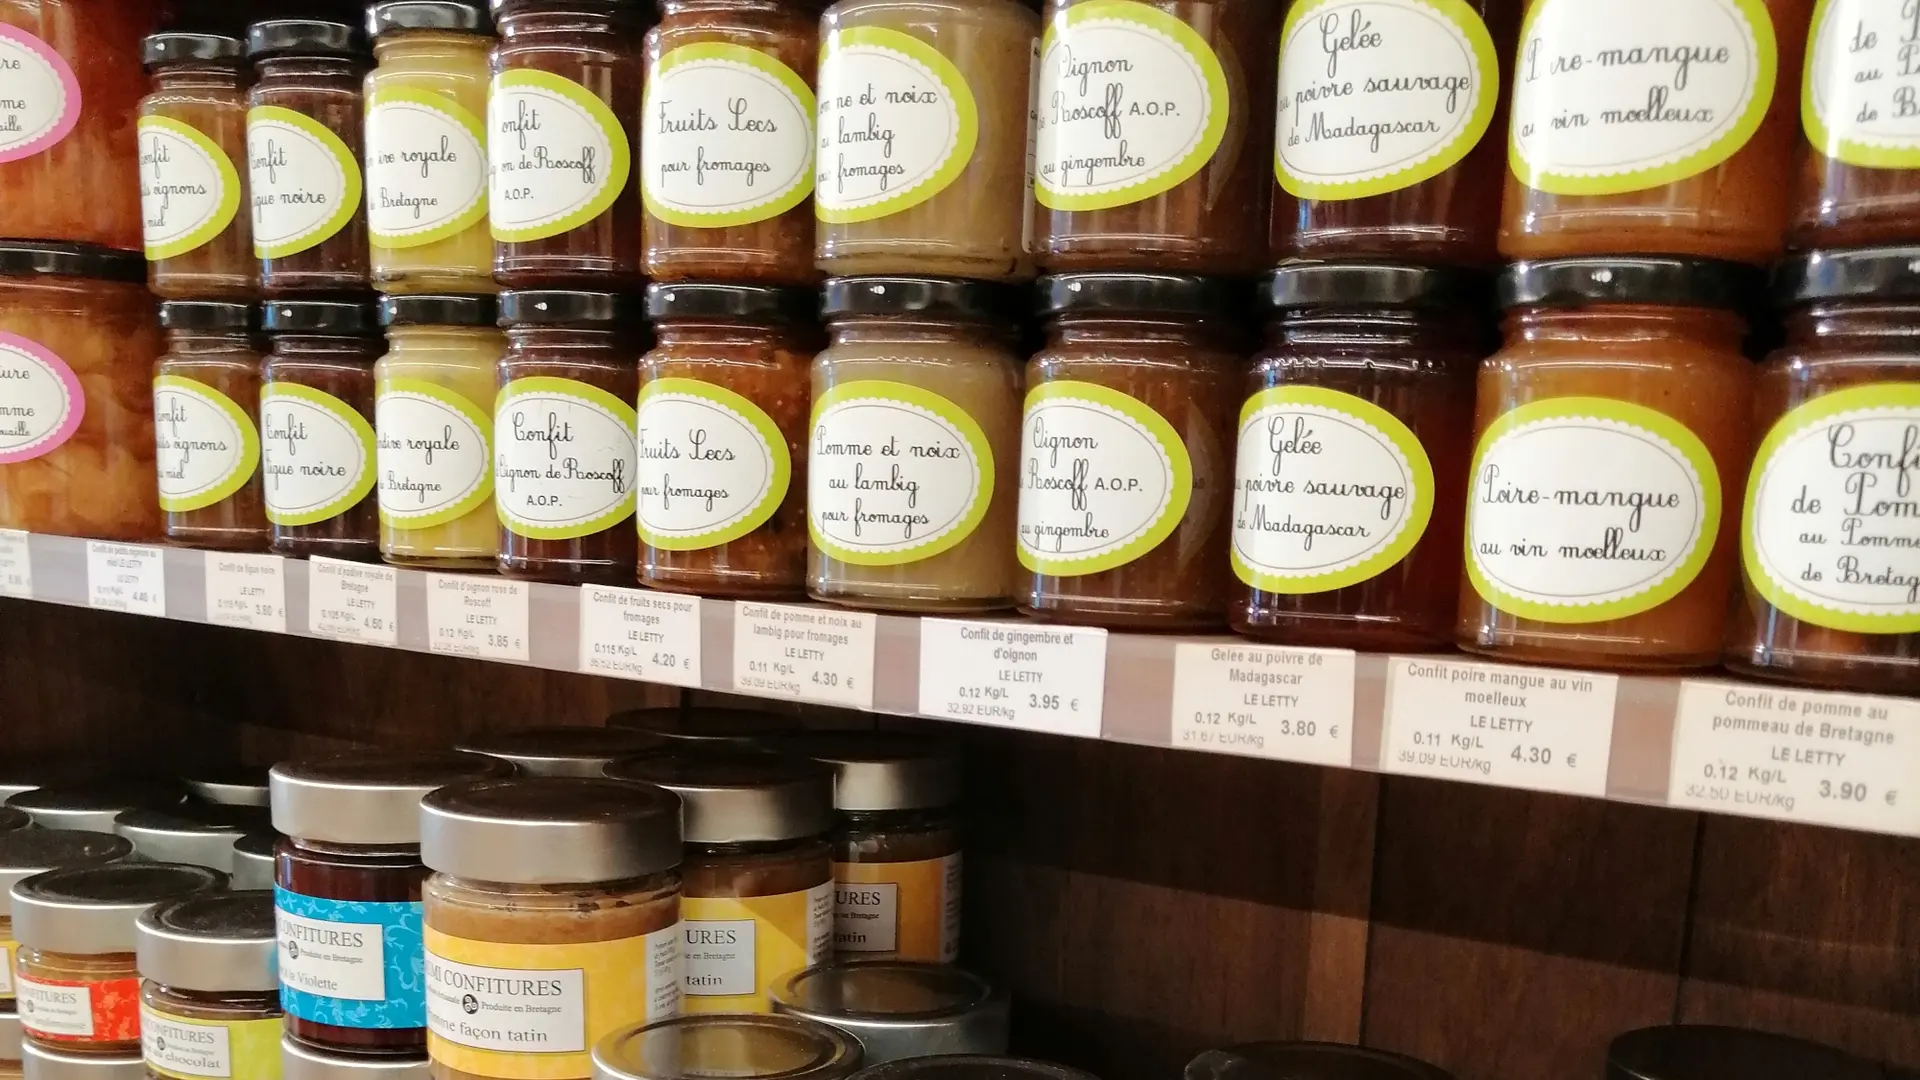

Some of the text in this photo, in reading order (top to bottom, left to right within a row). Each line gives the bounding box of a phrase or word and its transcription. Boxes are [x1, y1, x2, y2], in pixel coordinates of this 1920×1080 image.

[1320, 8, 1382, 79] Gelée
[1849, 19, 1878, 53] de
[1854, 68, 1883, 83] au
[859, 82, 938, 106] et noix
[1295, 75, 1470, 128] poivre sauvage
[502, 100, 542, 149] onfit
[658, 97, 778, 135] Fruits Secs
[1051, 83, 1181, 139] Roscoff A.O.P.
[1550, 109, 1589, 130] vin
[1856, 101, 1878, 123] de
[837, 112, 895, 159] lambig
[1288, 111, 1440, 154] de Madagascar
[401, 135, 457, 178] royale
[518, 145, 596, 184] de Roscoff
[661, 145, 771, 188] pour fromages
[1060, 139, 1146, 188] gingembre
[838, 153, 905, 194] fromages
[281, 188, 326, 204] noire
[406, 425, 460, 465] royale
[512, 412, 574, 460] Confit
[688, 428, 736, 461] Secs
[817, 424, 960, 459] Pomme et noix
[1033, 416, 1098, 468] Oignon
[1268, 416, 1322, 477] Gelée
[173, 437, 228, 463] oignons
[299, 461, 346, 477] noire
[545, 457, 625, 494] de Roscoff
[387, 470, 441, 503] Bretagne
[663, 473, 729, 512] fromages
[828, 462, 920, 509] au lambig
[1028, 457, 1143, 511] Roscoff A.O.P.
[1245, 473, 1406, 521] poivre sauvage
[526, 494, 563, 507] A.O.P.
[1482, 463, 1680, 533] Poire-mangue
[1791, 484, 1821, 515] de
[822, 497, 930, 539] pour fromages
[1034, 511, 1110, 552] gingembre
[1250, 504, 1370, 551] Madagascar
[1480, 541, 1502, 556] au
[1510, 538, 1549, 557] vin
[1799, 531, 1827, 545] au
[1800, 562, 1823, 582] de
[593, 591, 692, 613] Confit de fruits secs pour
[623, 610, 660, 626] fromages
[742, 605, 862, 629] Confit de pomme et noix au
[488, 634, 508, 648] 3.85
[628, 630, 664, 643] LE LETTY
[753, 623, 849, 646] lambig pour fromages
[961, 627, 1074, 645] Confit de gingembre et
[652, 653, 675, 667] 4.20
[785, 647, 825, 661] LE LETTY
[993, 647, 1038, 663] d'oignon
[1247, 651, 1323, 665] au poivre de
[750, 660, 838, 687] 0.11 4.30
[999, 669, 1042, 682] LE LETTY
[1229, 668, 1303, 686] Madagascar
[1407, 663, 1592, 693] Confit poire mangue au vin
[959, 686, 1079, 711] 0.12 Kg/L 3.95 €
[1244, 693, 1299, 707] LE LETTY
[1464, 691, 1527, 708] moelleux
[1725, 690, 1888, 720] Confit de pomme au
[1195, 712, 1338, 739] 0.12 Kg/L 3.80 €
[1470, 715, 1533, 733] LE LETTY
[1712, 715, 1895, 745] pommeau de Bretagne
[1414, 732, 1577, 768] 0.11 Kg/L 4.30 €
[1771, 745, 1846, 766] LE LETTY
[1704, 763, 1898, 806] 0.12 Kg/L 3.90 €
[836, 890, 880, 906] URES
[685, 929, 737, 945] URES
[443, 969, 563, 997] CONFITURES
[685, 974, 723, 986] tatin
[481, 1000, 563, 1015] Produite Bretagne
[459, 1021, 548, 1042] façon tatin
